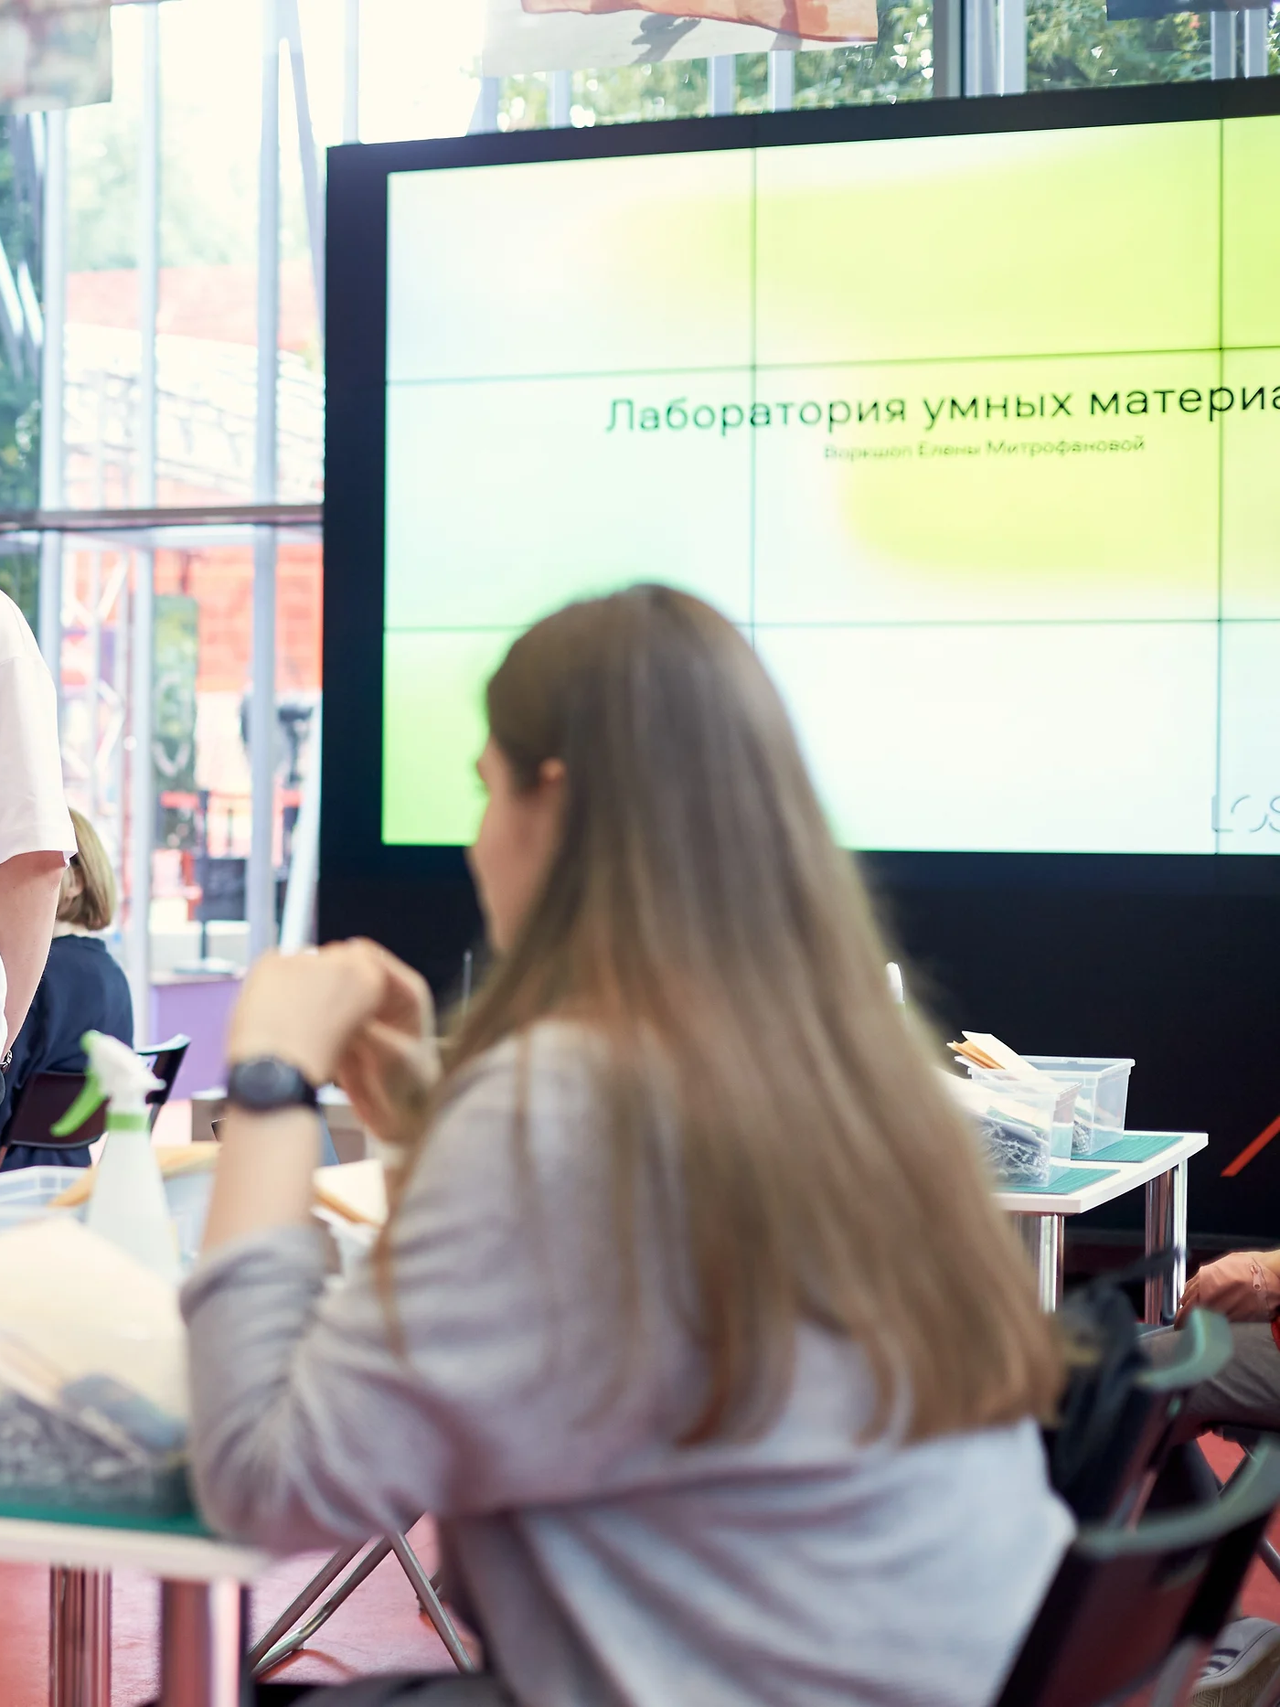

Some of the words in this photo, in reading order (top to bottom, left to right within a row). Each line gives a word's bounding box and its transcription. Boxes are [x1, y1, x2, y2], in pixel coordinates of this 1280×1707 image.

[606, 396, 906, 437] Лаборатория
[922, 393, 1073, 431] умных
[987, 434, 1146, 458] Митрофановой
